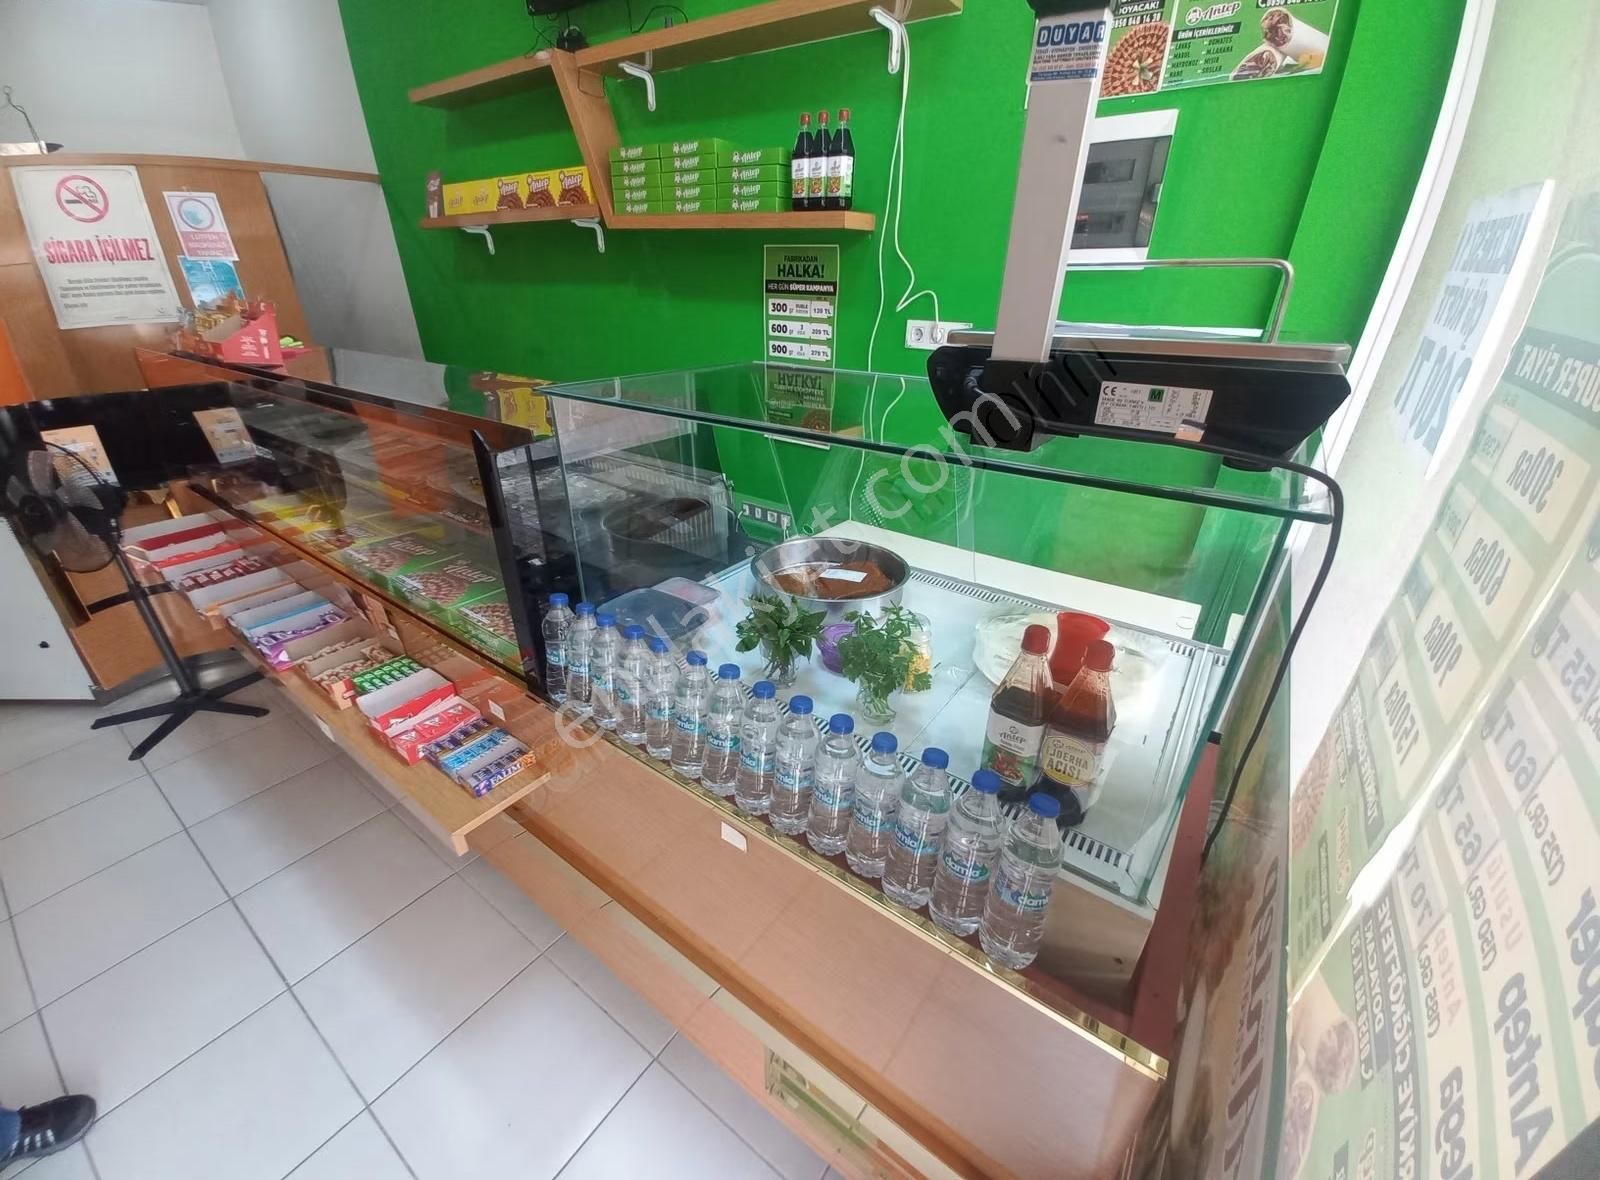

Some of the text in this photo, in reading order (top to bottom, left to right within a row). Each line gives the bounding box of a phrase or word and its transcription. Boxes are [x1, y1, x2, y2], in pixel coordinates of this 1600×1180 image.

[1202, 3, 1240, 19] Antep
[1039, 24, 1104, 44] DUYAR
[44, 234, 155, 265] SİGARA İÇİLMEZ
[777, 264, 825, 279] HALKA!
[778, 283, 789, 291] GÜN
[790, 283, 806, 292] SÜPER
[806, 284, 834, 293] KAMPANYA
[771, 303, 787, 313] 300
[771, 324, 787, 334] 600
[771, 344, 787, 354] 900
[999, 731, 1026, 745] Antep
[489, 761, 522, 786] FALIM
[943, 857, 981, 878] damla
